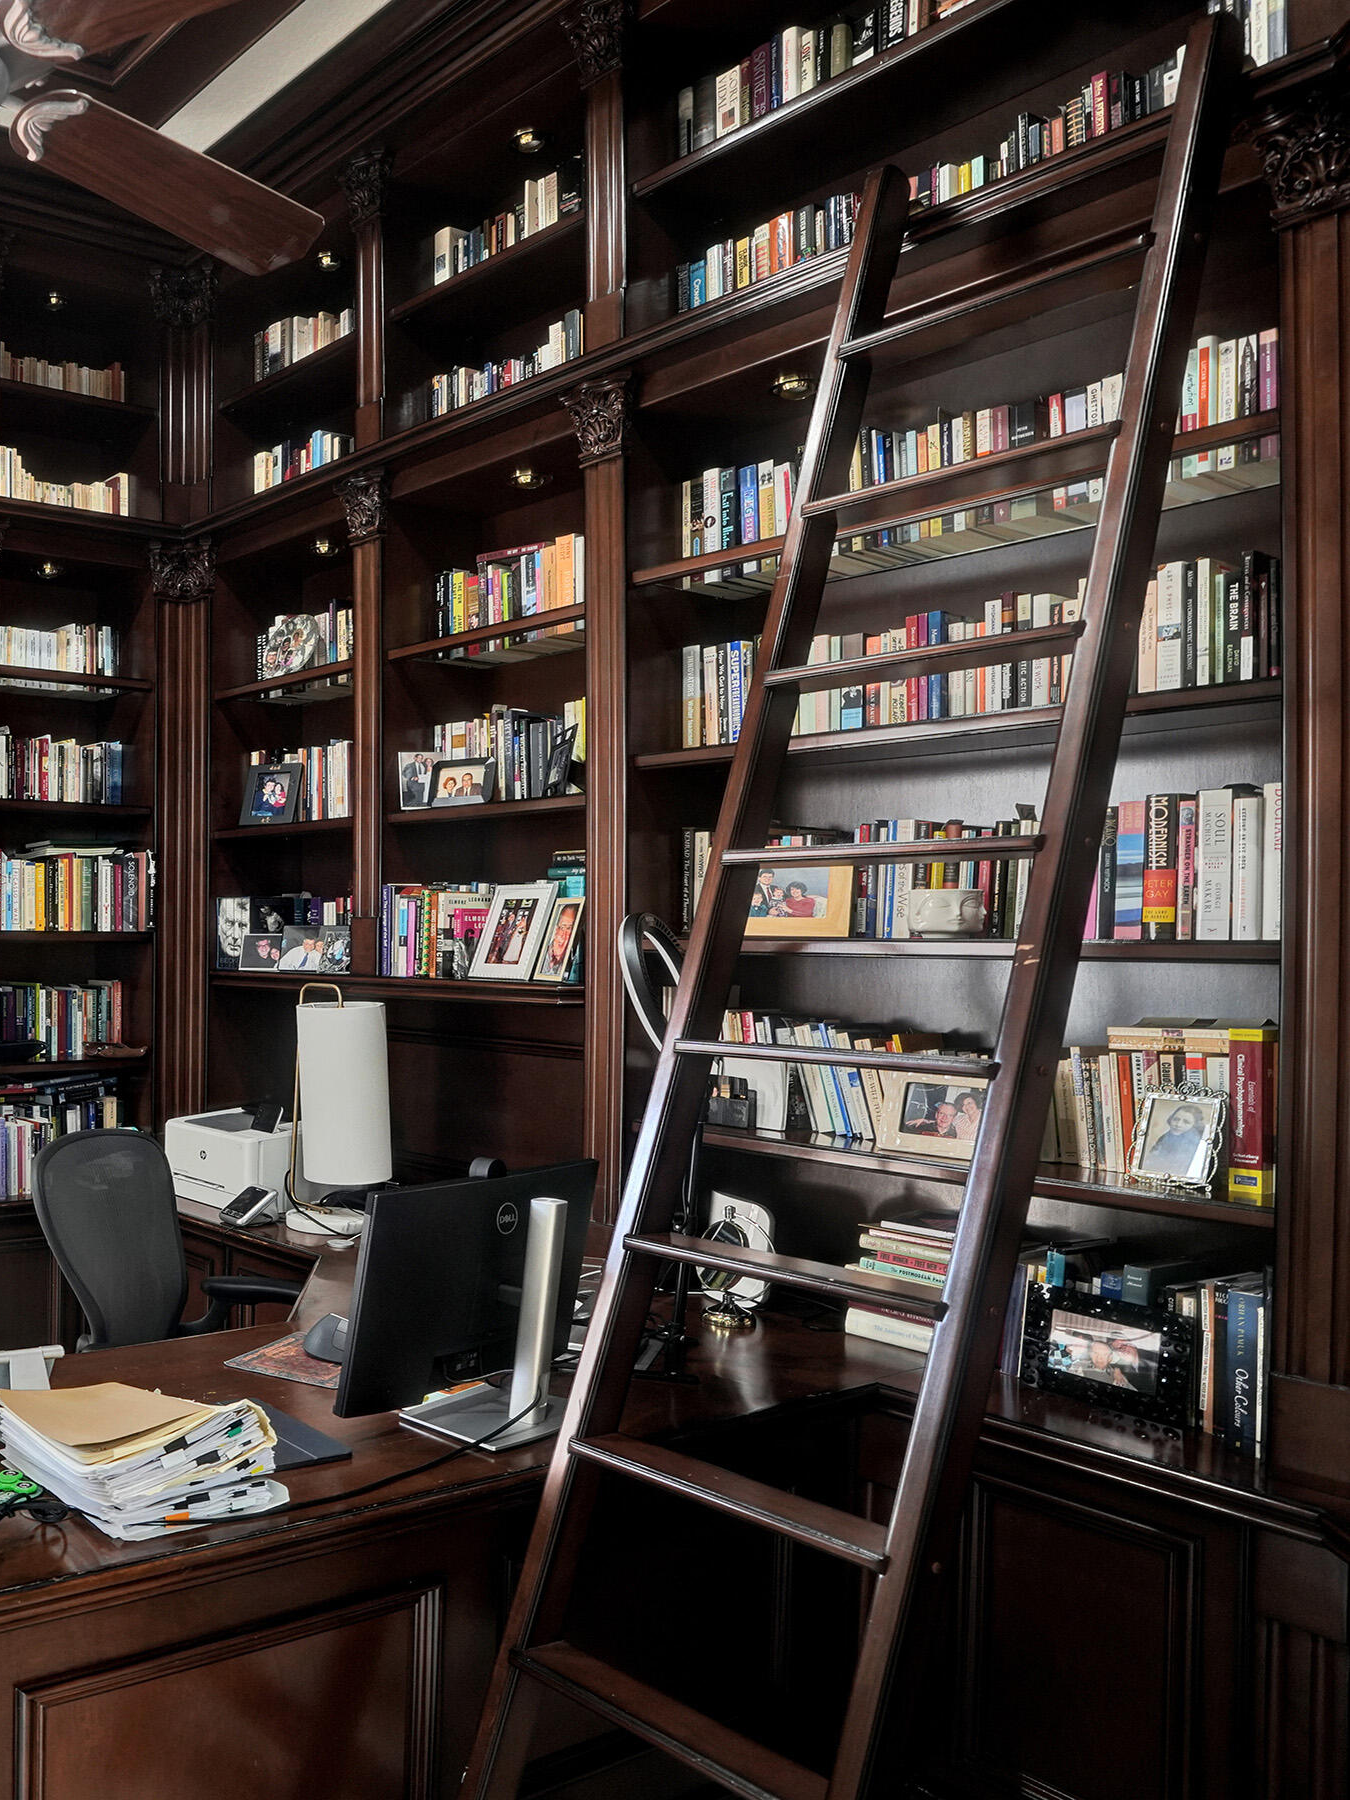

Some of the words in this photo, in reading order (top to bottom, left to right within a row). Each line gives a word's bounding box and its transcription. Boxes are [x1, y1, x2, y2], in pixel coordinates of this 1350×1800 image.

[729, 70, 739, 106] GORE
[753, 51, 765, 97] SARTRE
[717, 76, 728, 112] VIDAL
[1229, 582, 1239, 601] THE
[1229, 603, 1239, 631] BRAIN
[1148, 796, 1169, 868] MODERNISM
[1204, 812, 1212, 847] MACHINE
[1214, 812, 1226, 847] SOUL
[1183, 829, 1193, 860] STRANGER
[127, 861, 135, 897] SOLENOID
[1183, 861, 1192, 871] ON
[1183, 872, 1192, 885] THE
[896, 894, 908, 918] Wise
[1146, 889, 1169, 898] GAY
[1183, 885, 1192, 905] EARTH
[1203, 879, 1213, 914] MAKARI
[1236, 1054, 1245, 1075] Clinical
[1235, 1076, 1245, 1138] Psychopharmacology
[1247, 1081, 1257, 1105] Essentials
[499, 1213, 516, 1224] DELL
[1237, 1328, 1245, 1356] PAMUK
[1234, 1368, 1249, 1395] Other
[1234, 1395, 1249, 1427] Colours
